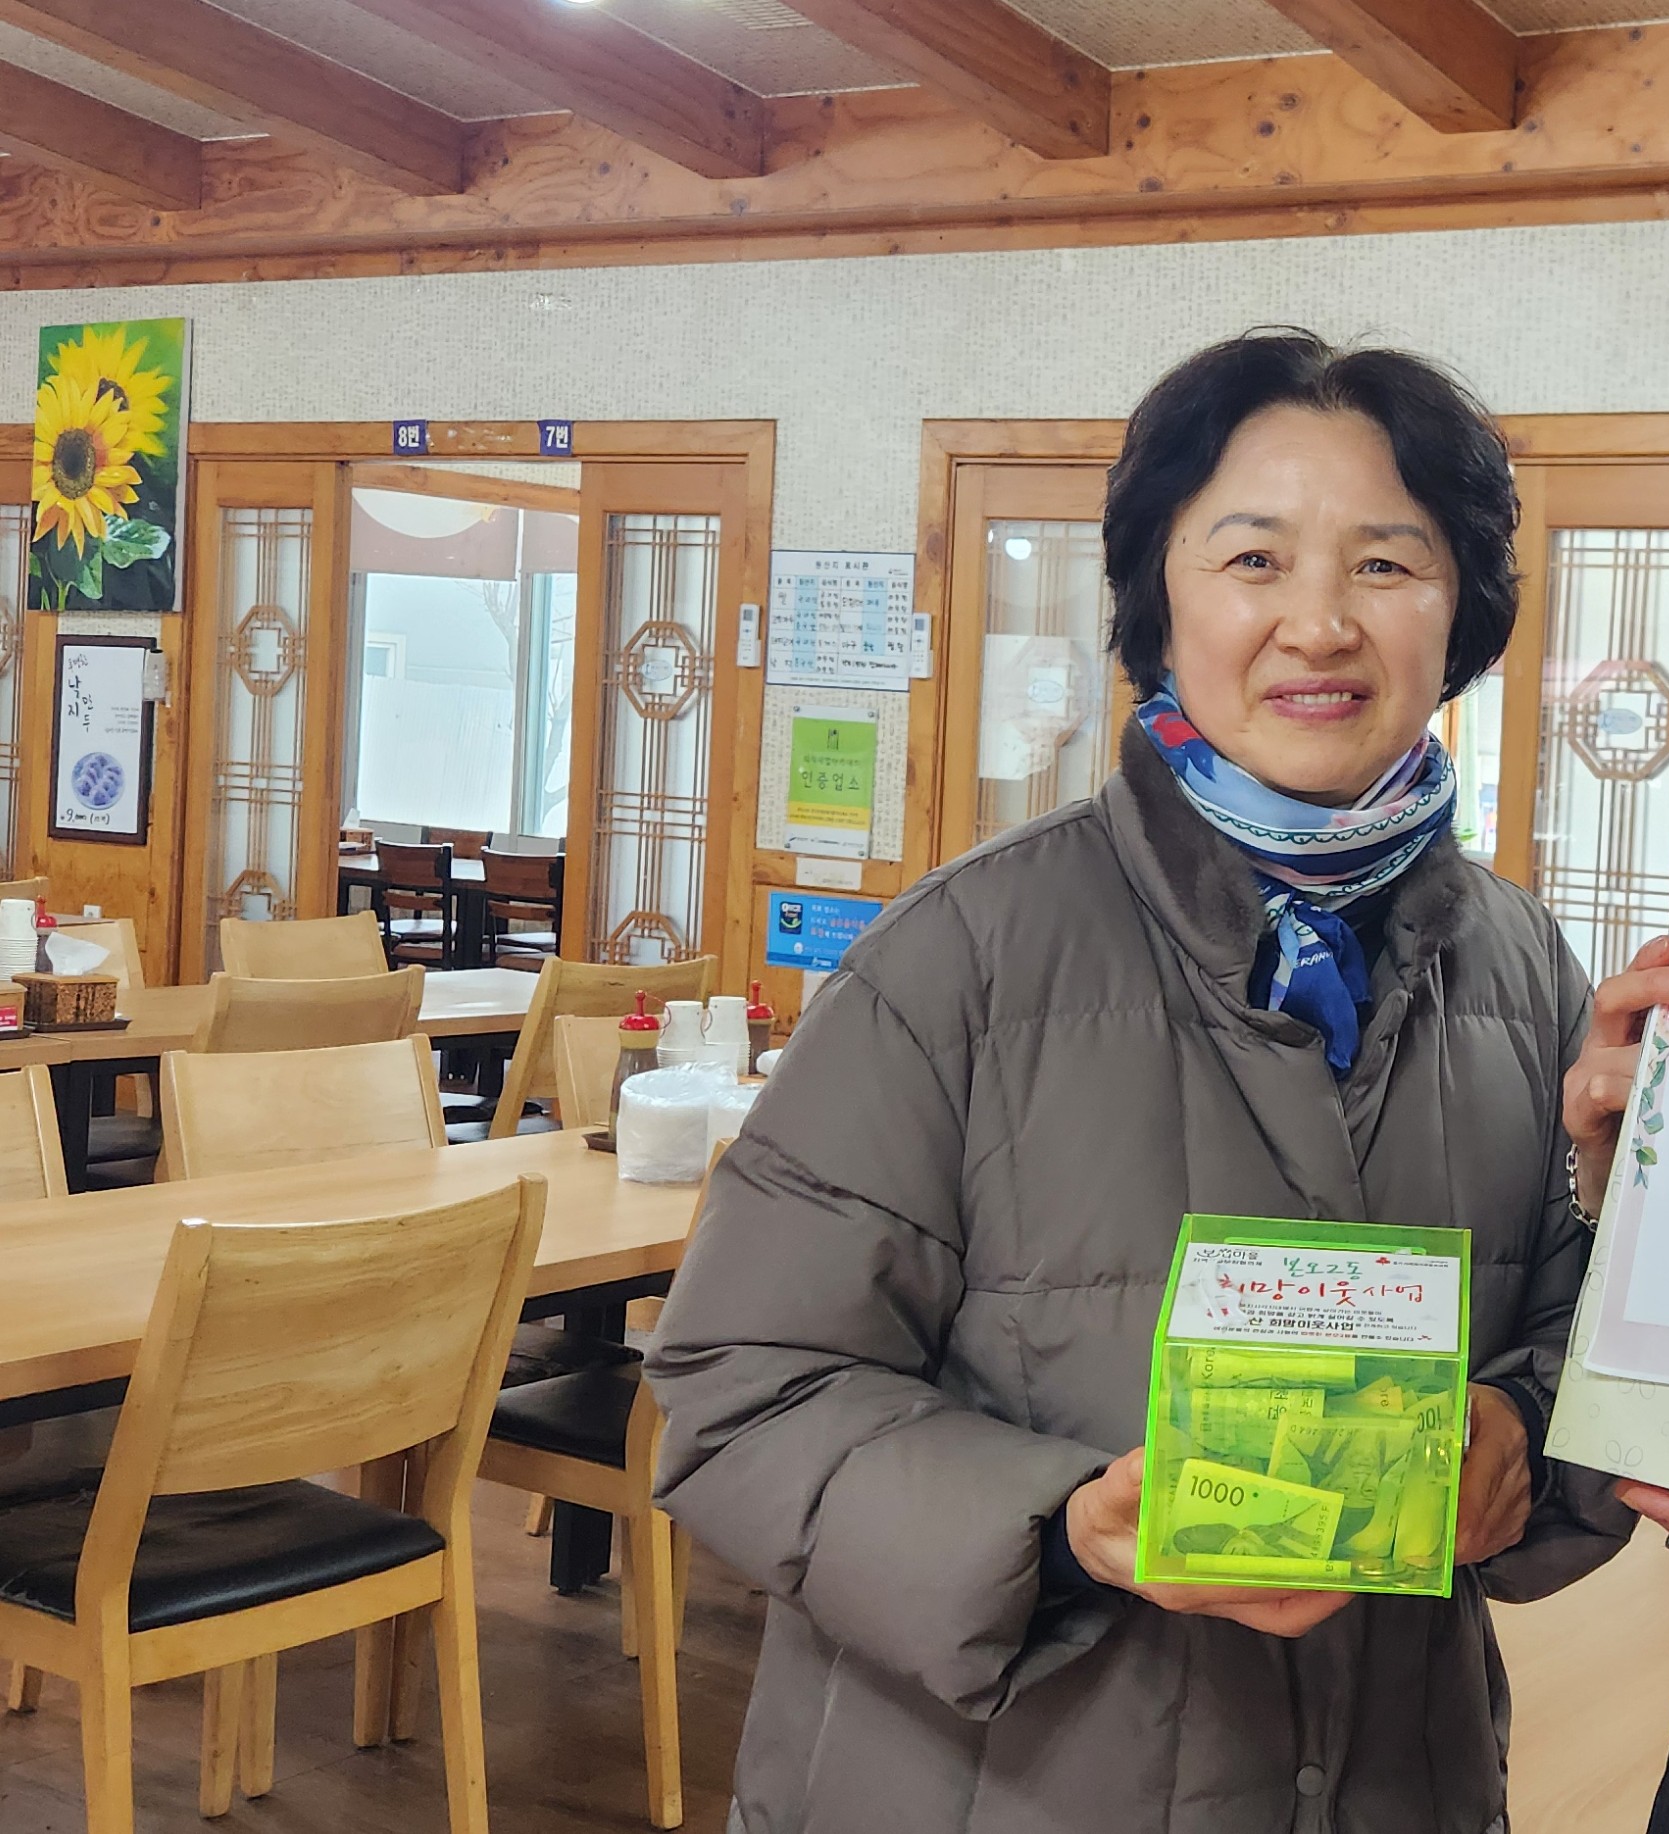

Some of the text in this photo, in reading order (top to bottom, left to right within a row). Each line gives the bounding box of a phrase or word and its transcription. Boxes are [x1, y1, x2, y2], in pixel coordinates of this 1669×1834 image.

[398, 425, 420, 448] 8번
[545, 426, 568, 448] 7번
[82, 694, 93, 733] 만두
[801, 770, 860, 791] 인증업소
[1284, 1257, 1362, 1280] 본오2동
[1189, 1475, 1245, 1507] 1000
